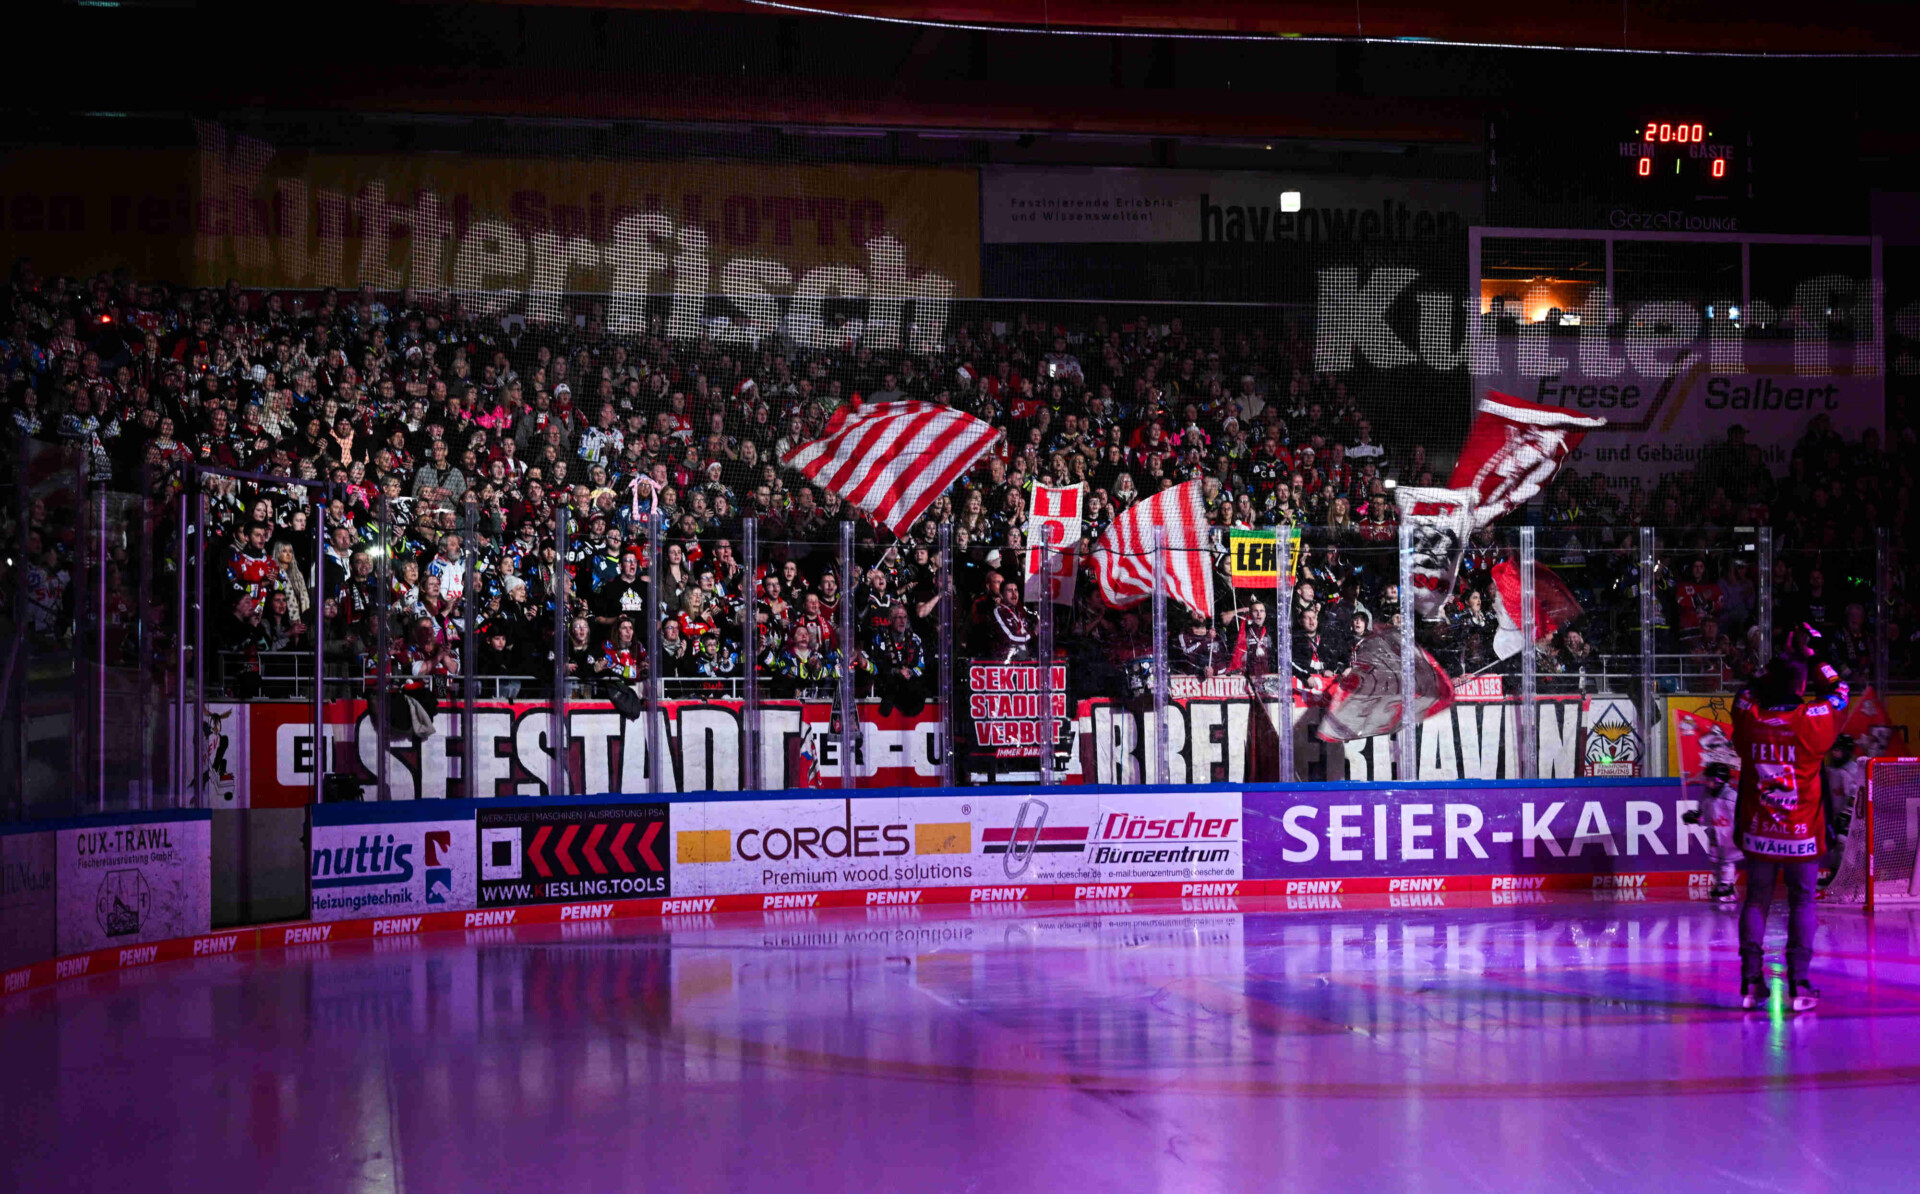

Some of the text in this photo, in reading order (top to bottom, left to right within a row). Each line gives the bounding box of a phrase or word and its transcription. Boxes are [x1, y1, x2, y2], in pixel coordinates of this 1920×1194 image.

[1645, 123, 1703, 142] 20:00
[1619, 142, 1655, 157] HEIM
[1639, 157, 1650, 176] 0
[1712, 158, 1724, 177] 0
[1012, 211, 1037, 222] und
[1201, 194, 1461, 243] havenwelten
[192, 113, 956, 357] Kutterfisch
[1536, 375, 1840, 410] Frese Salbert
[1596, 444, 1630, 462] und
[969, 665, 1066, 692] SEKTION
[970, 693, 1066, 719] STADION
[974, 719, 1062, 746] VERBOT
[1751, 742, 1796, 762] FELIX
[481, 808, 665, 823] WERKZEUGE MASCHINEN AUSRÜSTUNG PSA
[1102, 811, 1239, 840] Döscher
[77, 828, 173, 856] CUX-TRAWL
[1754, 840, 1816, 855] WÄHLER
[312, 834, 413, 883] nuttis
[1095, 846, 1230, 864] Bürozentrum
[763, 864, 973, 886] Premium wood solutions
[1688, 873, 1741, 886] PEN
[312, 888, 413, 911] Heizungstechnik
[481, 876, 666, 902] WWW.KIESLING.TOOLS
